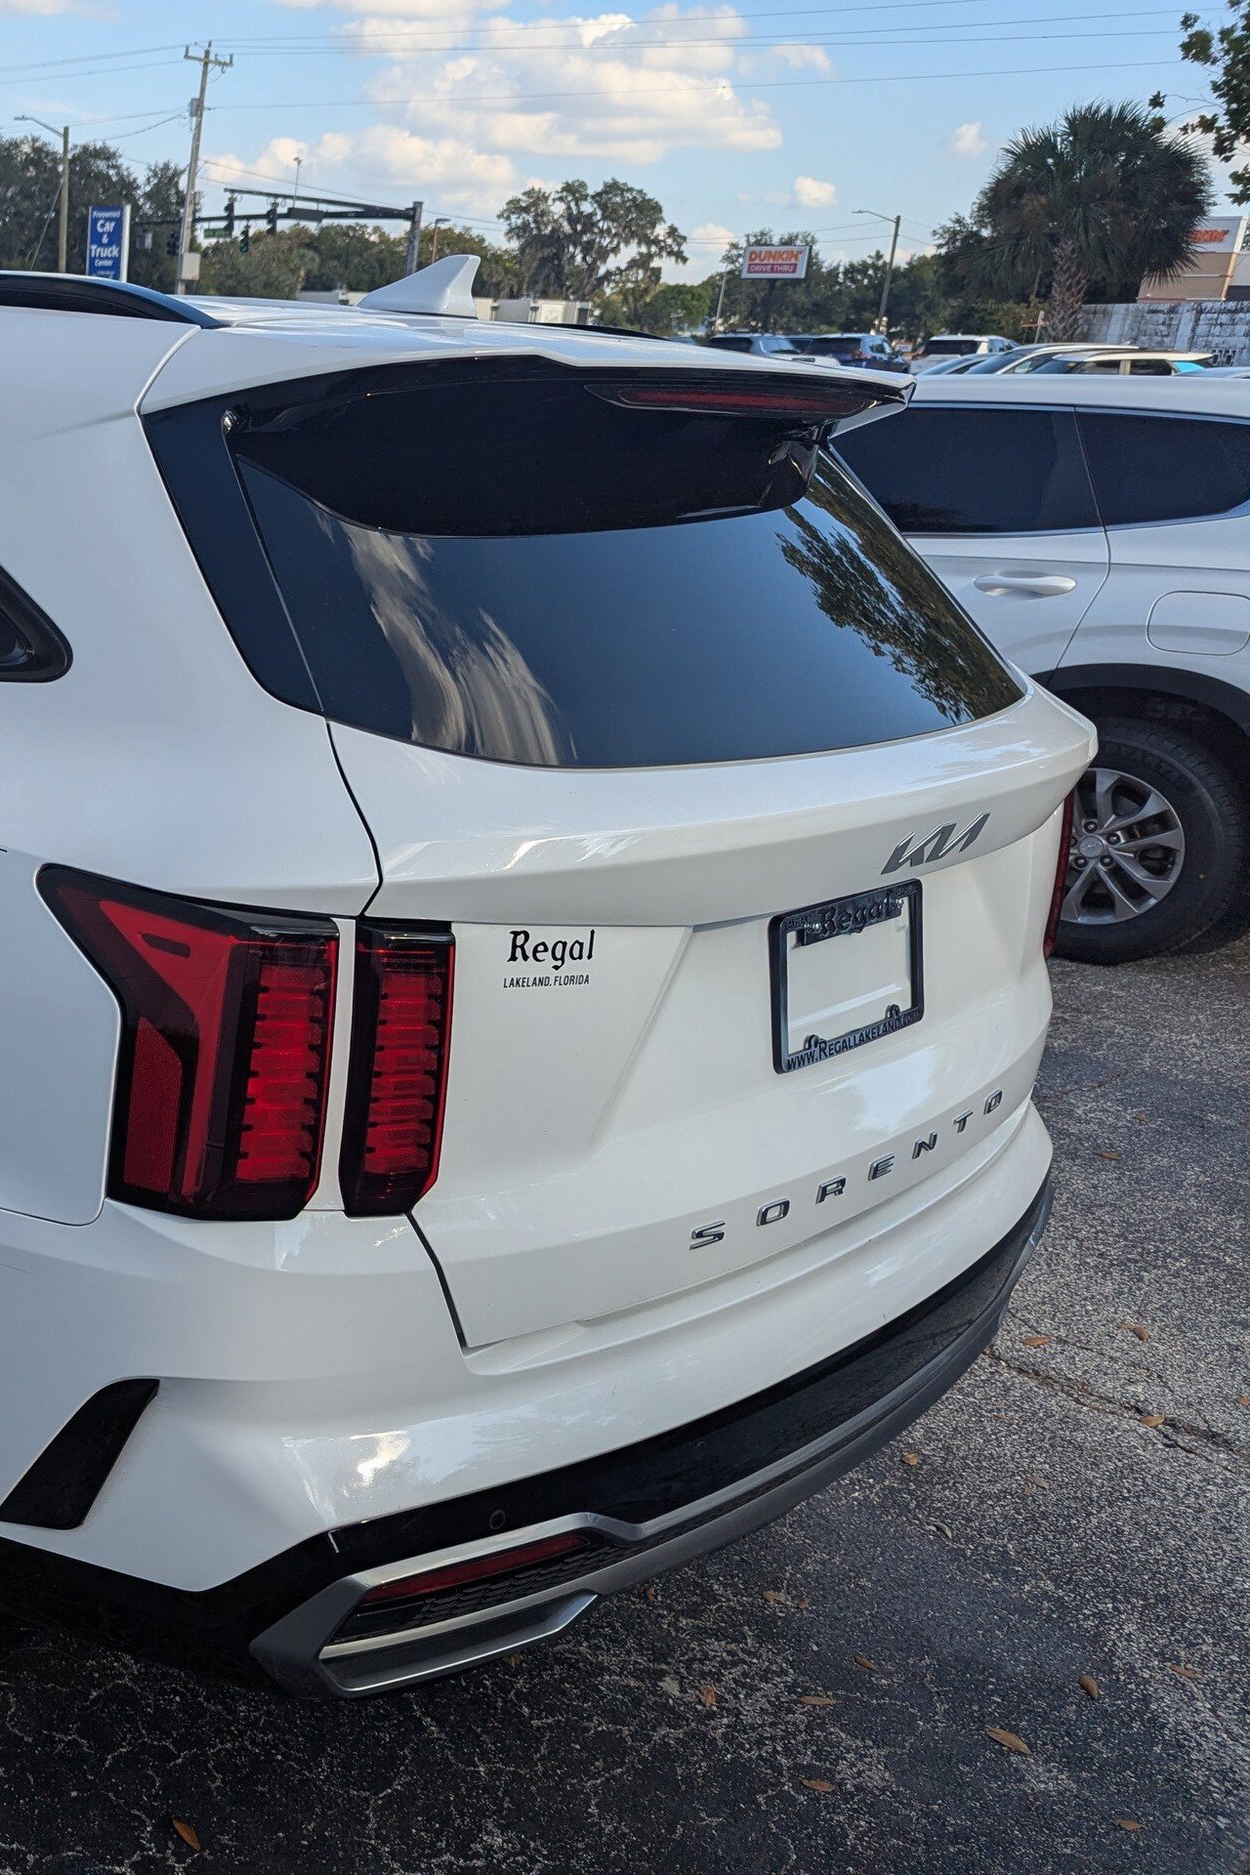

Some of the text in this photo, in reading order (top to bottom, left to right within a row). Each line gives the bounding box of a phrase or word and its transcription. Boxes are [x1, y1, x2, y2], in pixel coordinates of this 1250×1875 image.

[96, 219, 116, 233] Car
[102, 234, 109, 244] &
[90, 244, 120, 258] Truck
[750, 264, 794, 273] DRIVE THRU
[507, 929, 595, 971] Regal
[553, 974, 590, 986] FLORIDA
[688, 1087, 1003, 1251] SORENTO
